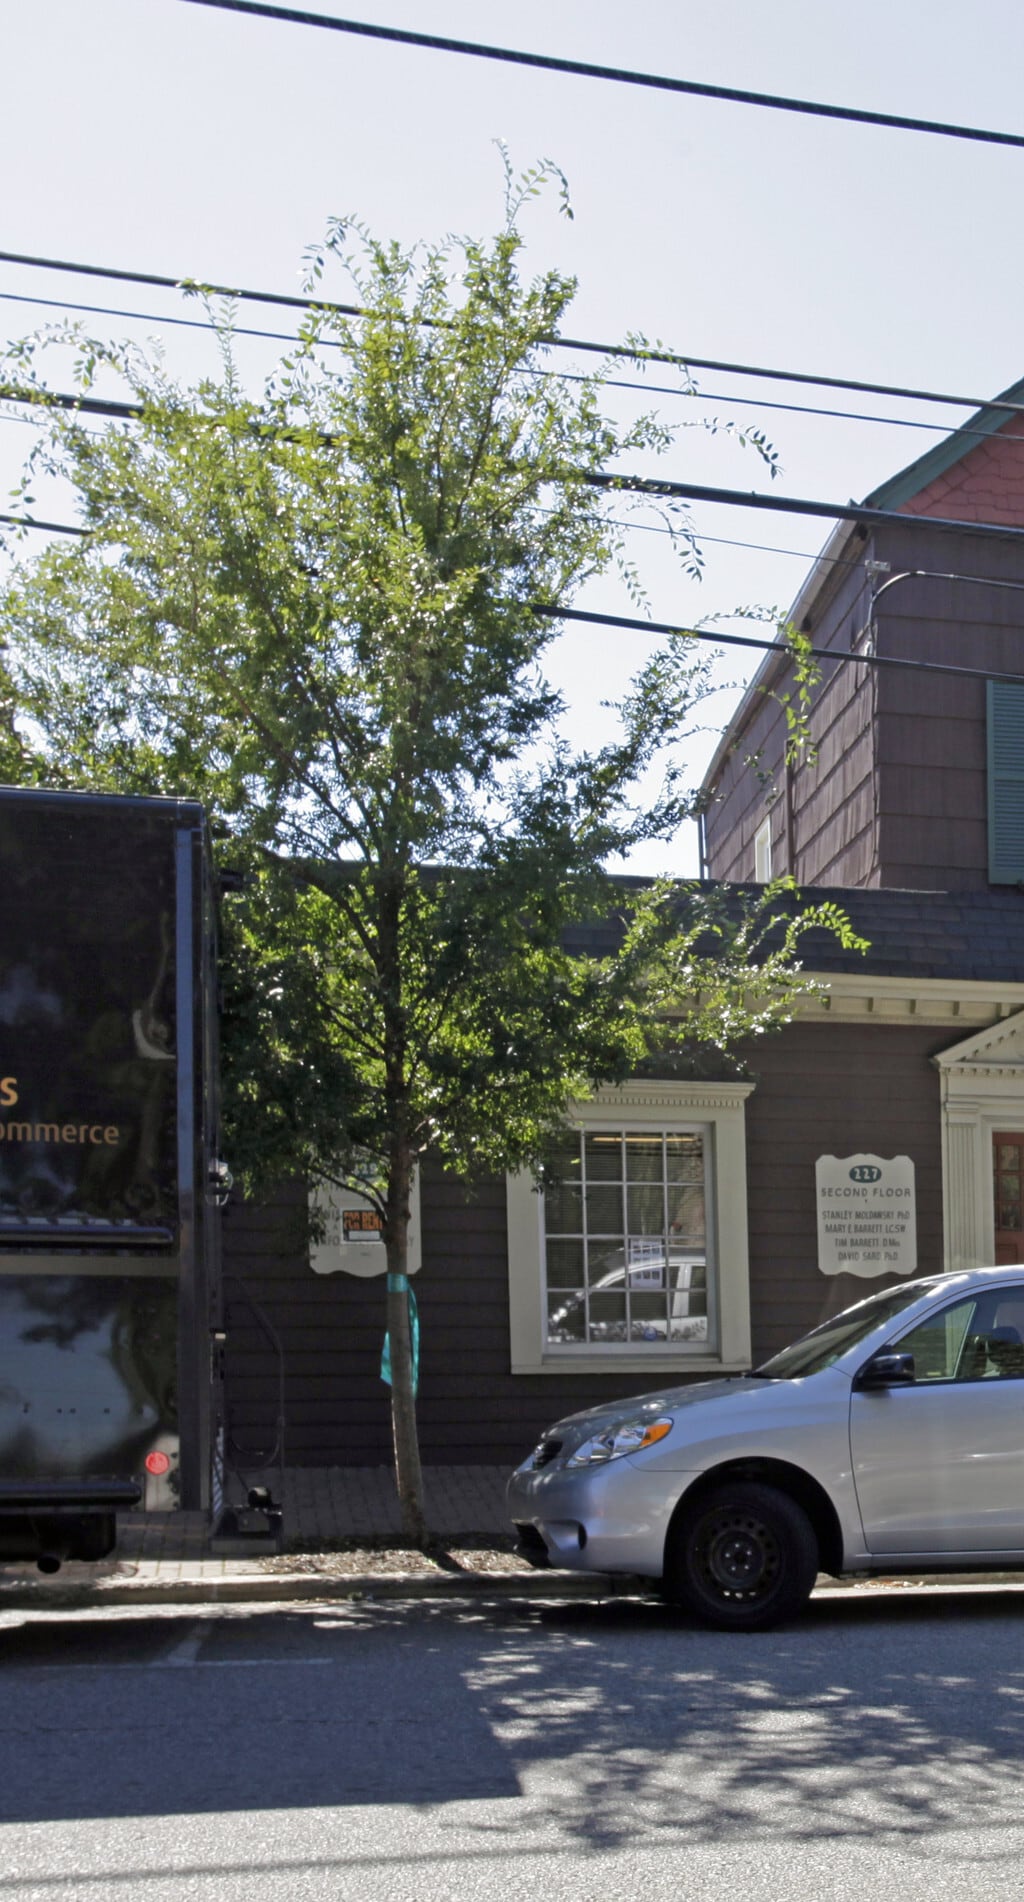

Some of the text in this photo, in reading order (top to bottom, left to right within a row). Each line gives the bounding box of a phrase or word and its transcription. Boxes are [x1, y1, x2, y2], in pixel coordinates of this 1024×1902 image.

[854, 1167, 878, 1180] 227
[821, 1187, 911, 1197] SECOND FLOOR
[822, 1210, 852, 1220] STANLEY
